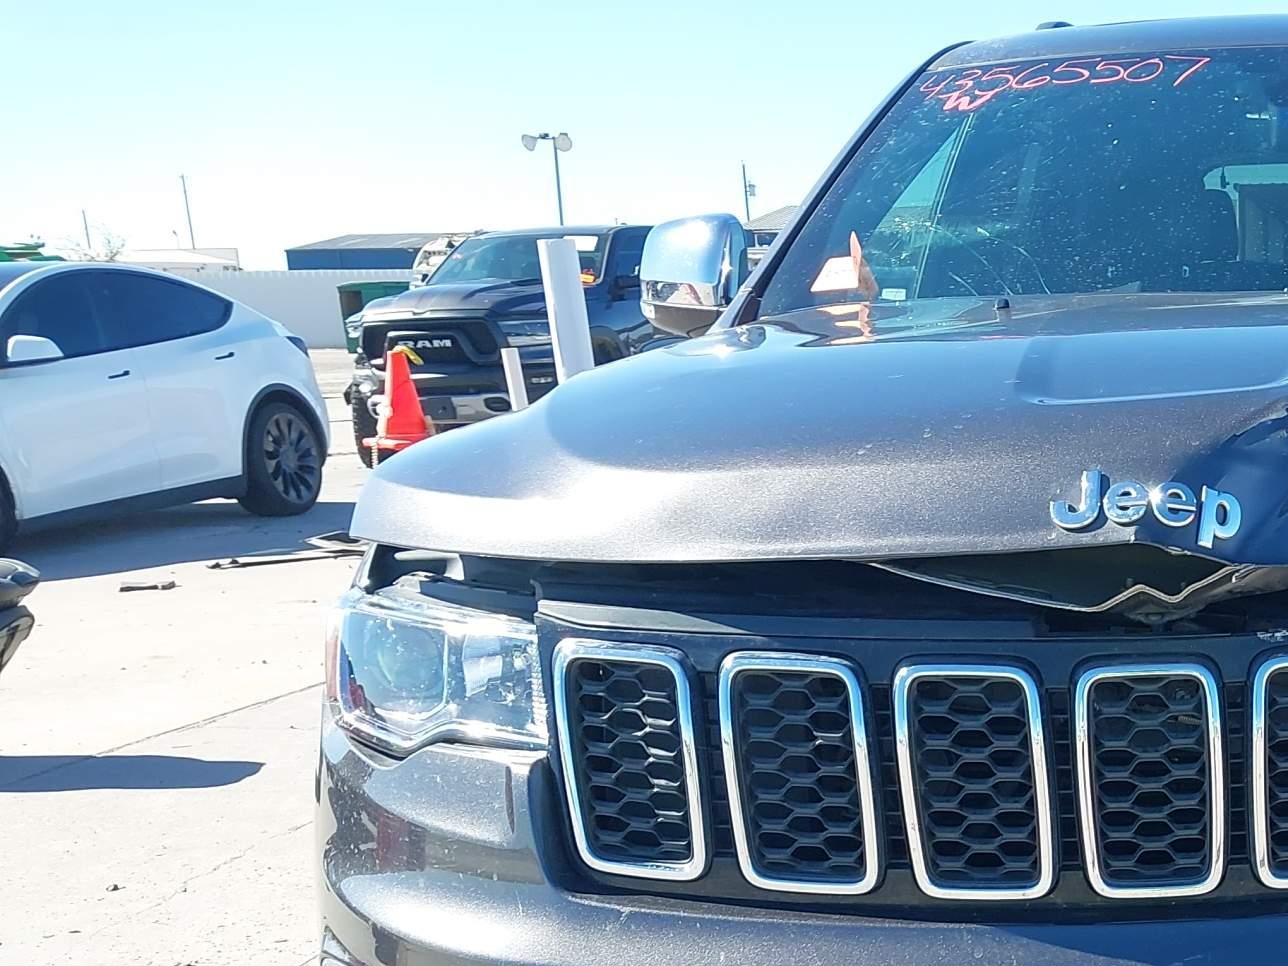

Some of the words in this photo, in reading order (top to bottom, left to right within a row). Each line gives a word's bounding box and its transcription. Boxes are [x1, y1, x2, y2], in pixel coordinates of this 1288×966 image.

[920, 55, 1211, 99] 43565507
[397, 339, 452, 348] RAM
[1050, 468, 1242, 549] Jeep
